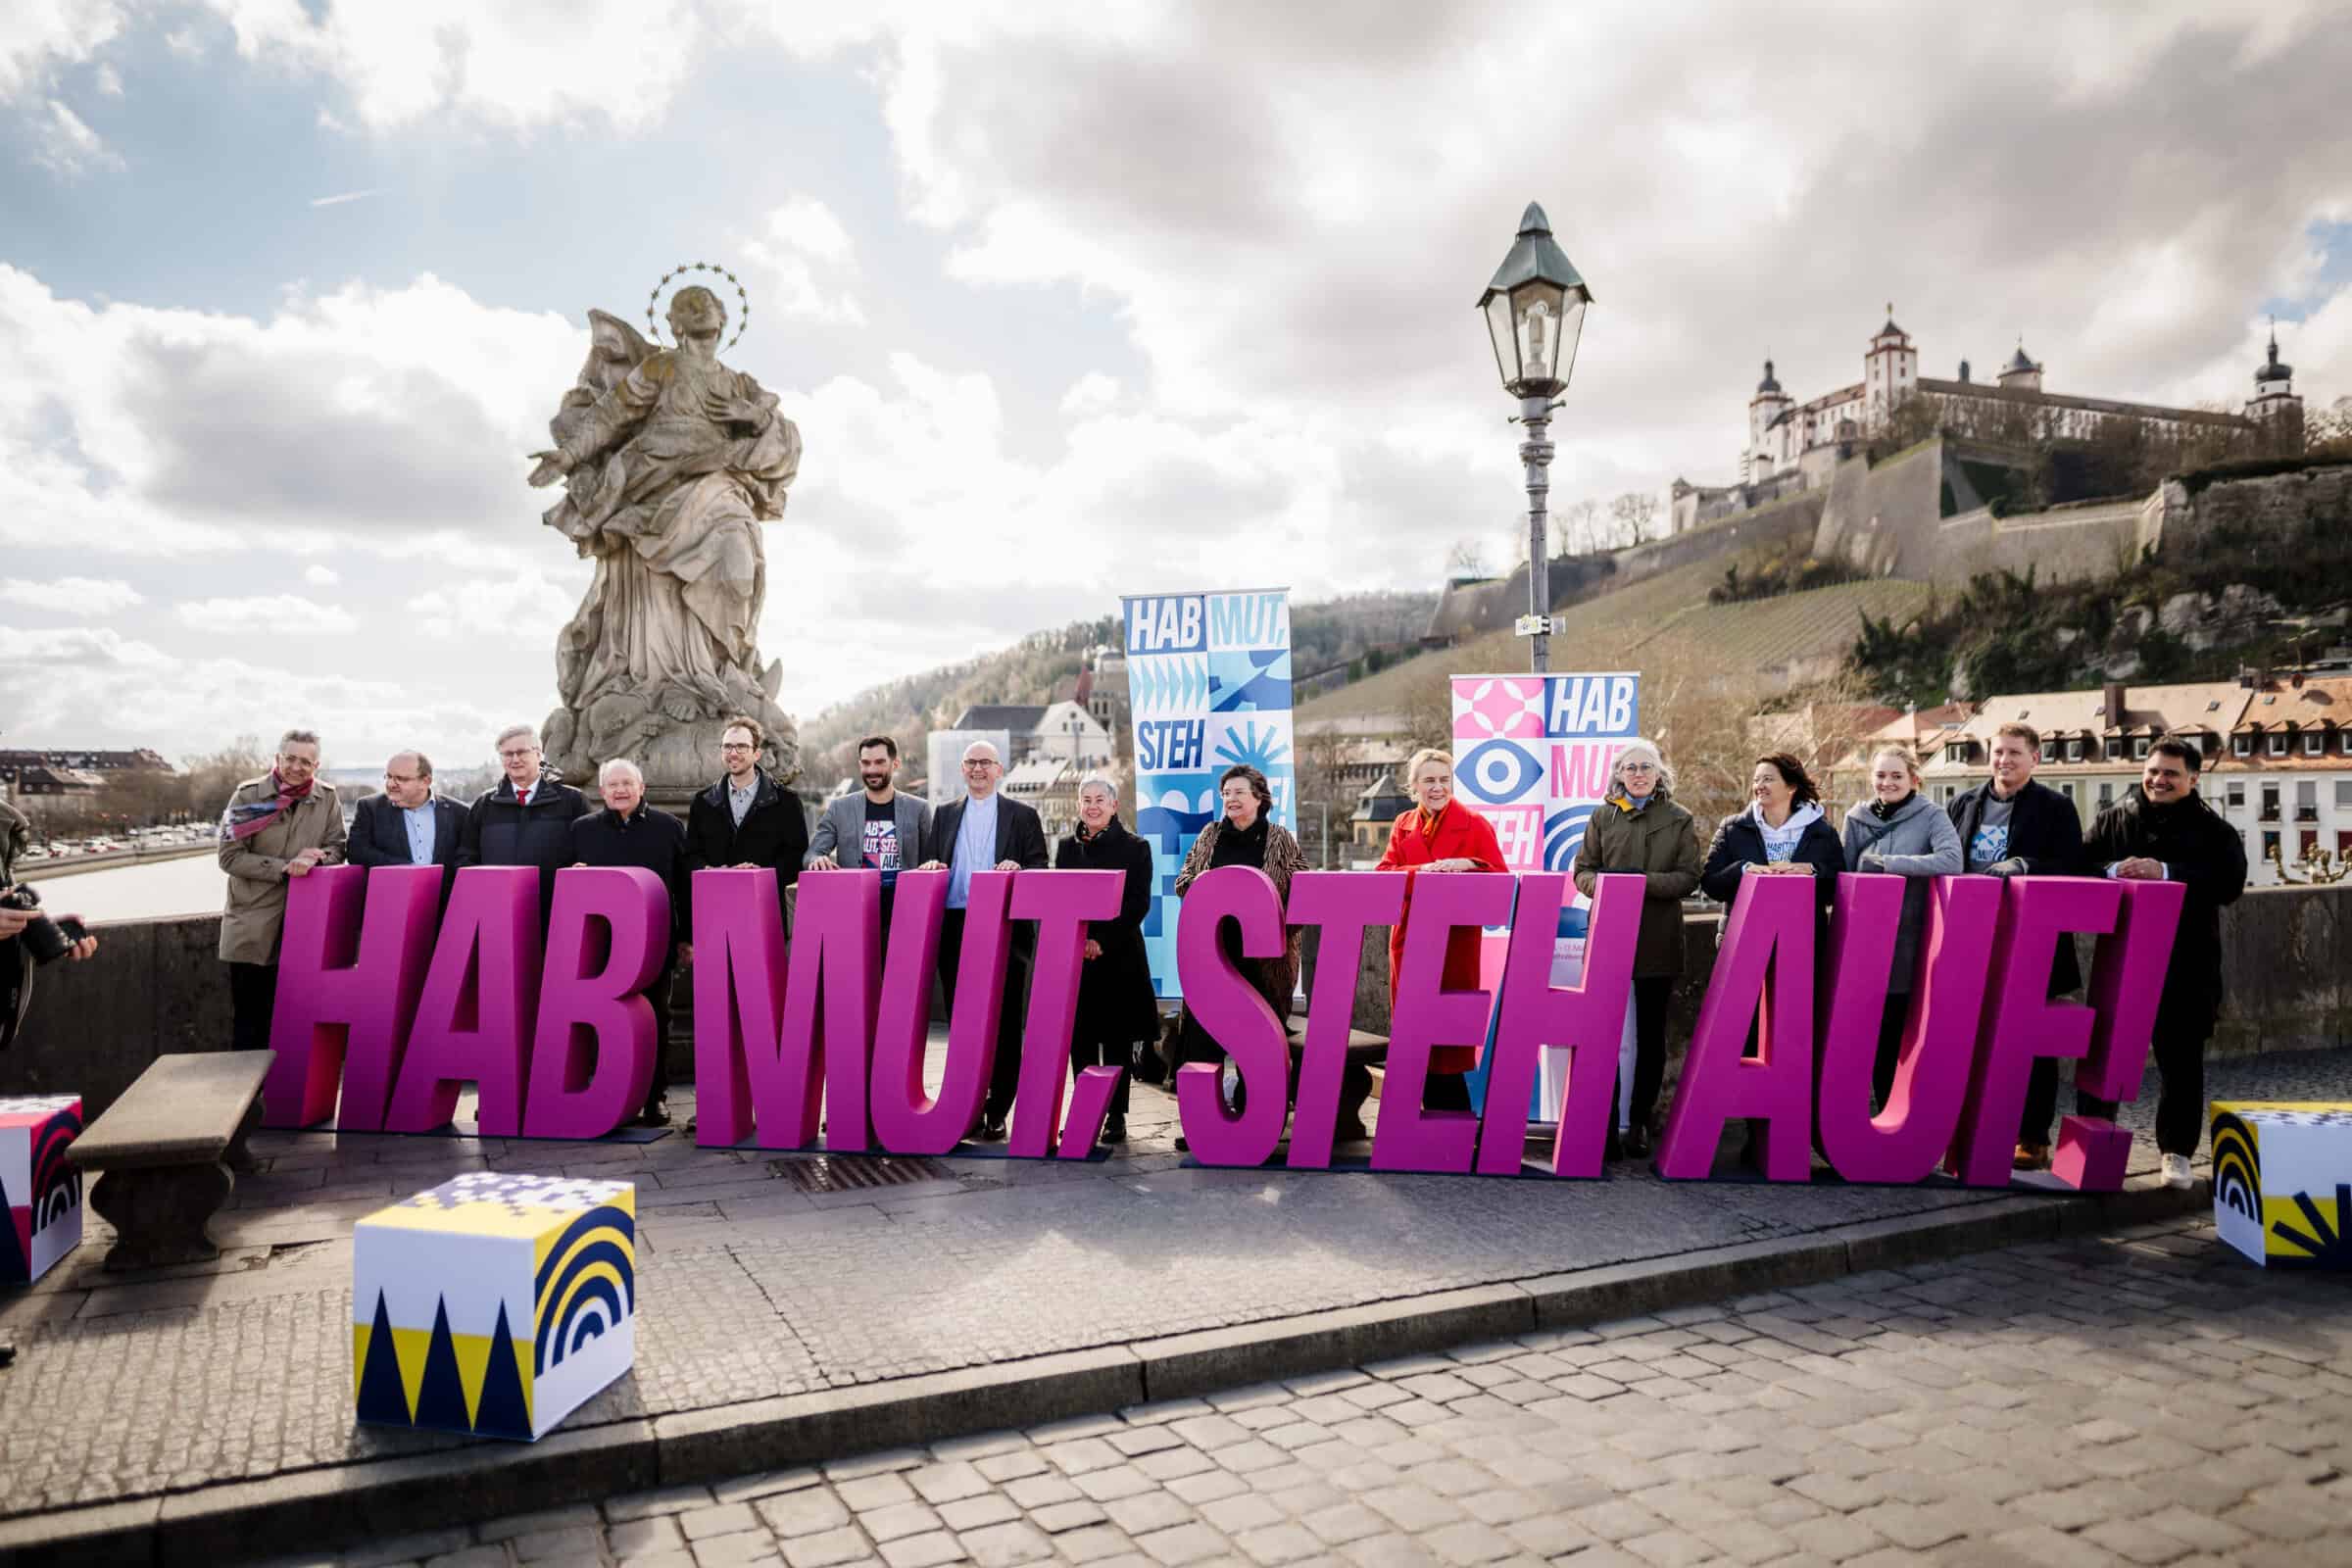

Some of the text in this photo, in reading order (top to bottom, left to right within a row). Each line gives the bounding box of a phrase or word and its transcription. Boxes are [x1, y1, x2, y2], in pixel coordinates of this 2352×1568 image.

[1130, 594, 1286, 651] HAB MUT,
[1549, 677, 1634, 732] HAB
[1138, 719, 1205, 770] STEH
[1551, 744, 1627, 799] MU
[864, 821, 879, 837] AB
[264, 864, 2187, 1191] HAB MUT, STEH AUF!
